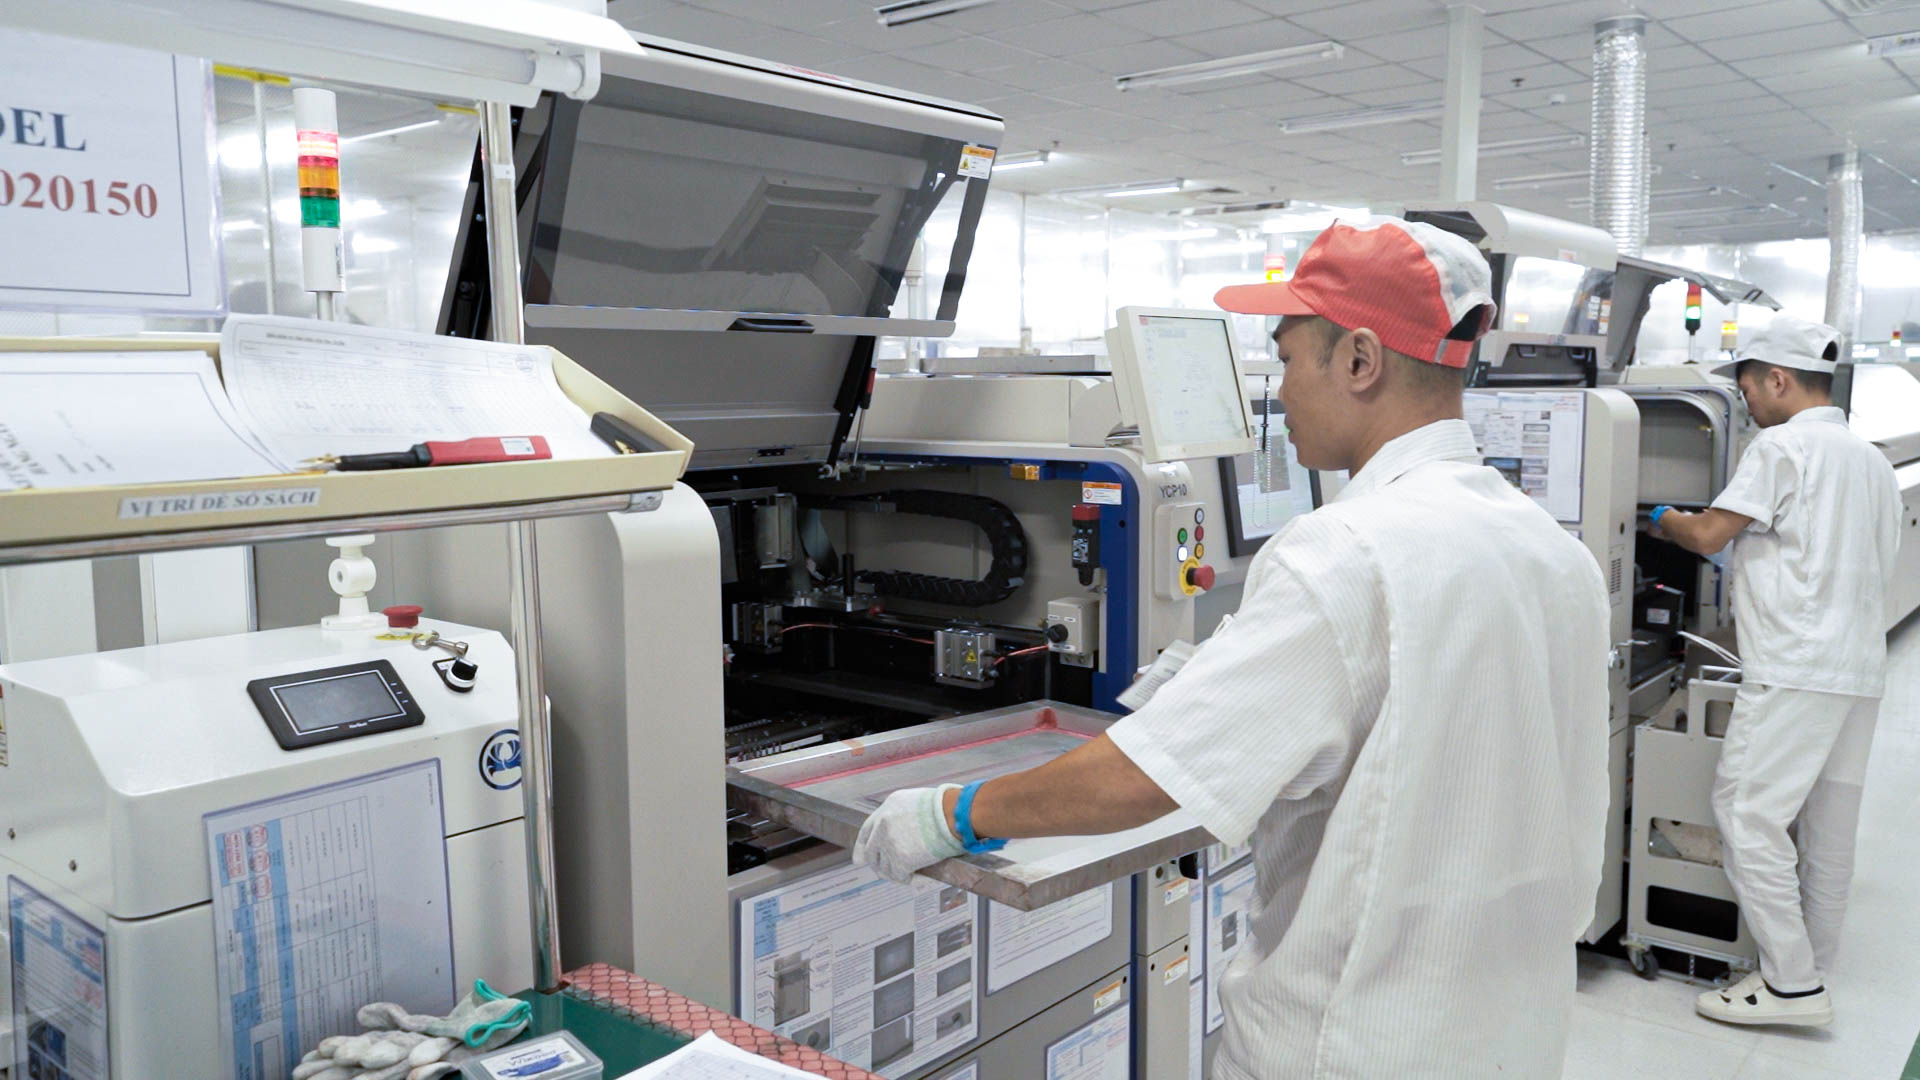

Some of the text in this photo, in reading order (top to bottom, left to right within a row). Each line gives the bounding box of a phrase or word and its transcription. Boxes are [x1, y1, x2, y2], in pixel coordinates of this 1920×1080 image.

[0, 107, 87, 151] EL
[0, 168, 158, 219] 020150
[1159, 483, 1187, 498] YCP10
